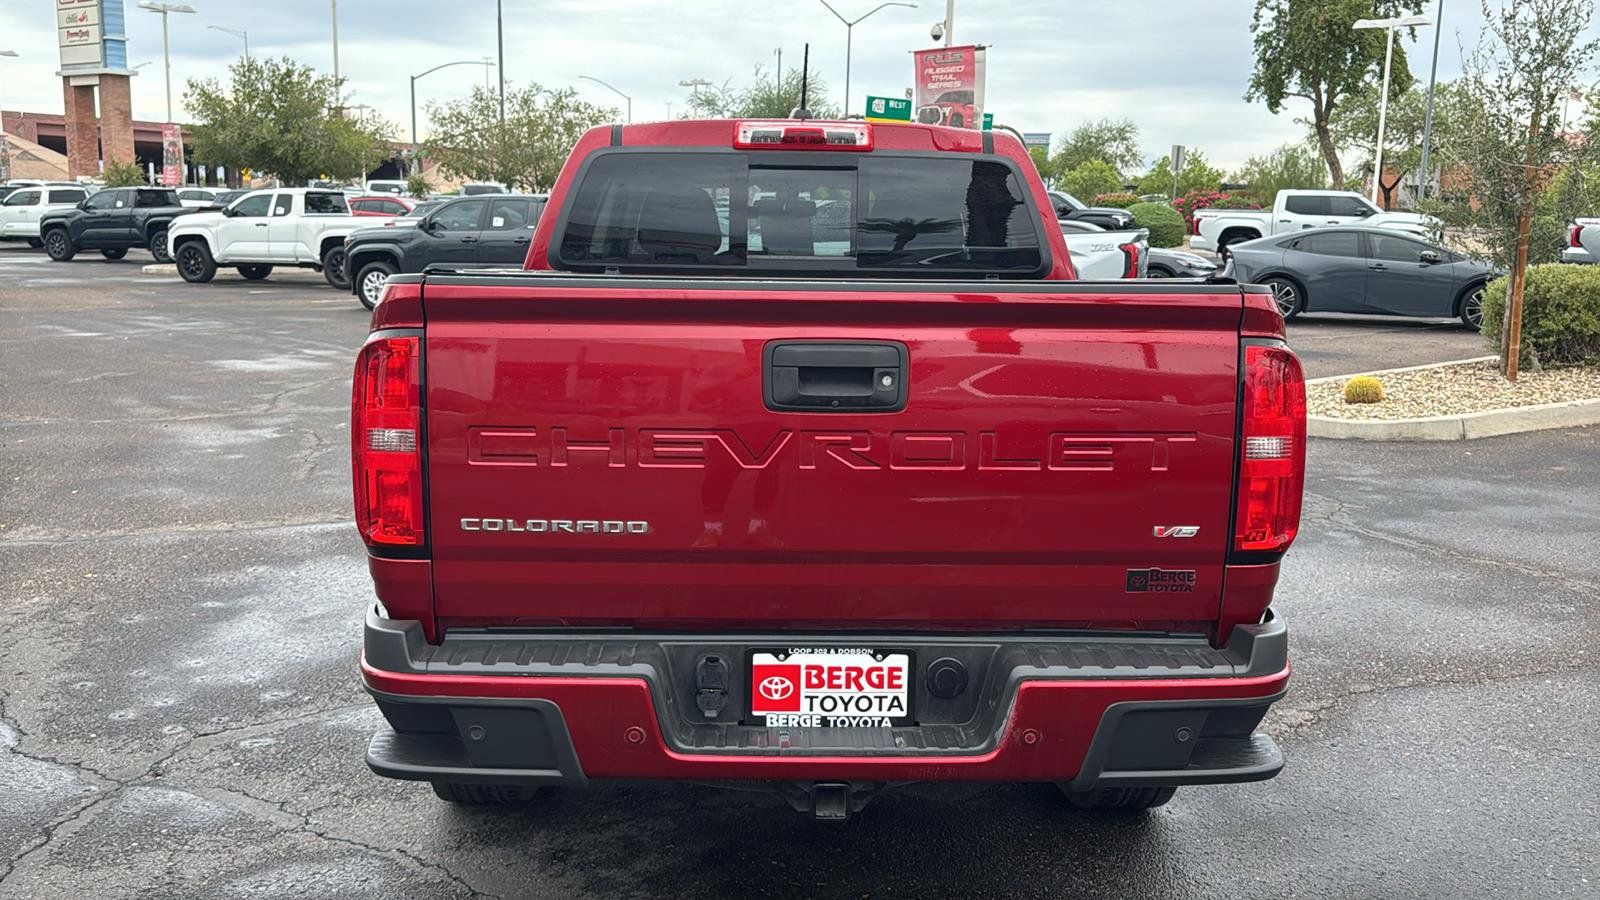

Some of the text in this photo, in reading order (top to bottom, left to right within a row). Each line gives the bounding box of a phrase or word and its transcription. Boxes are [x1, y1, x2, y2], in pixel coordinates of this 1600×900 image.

[924, 65, 965, 75] RUGGED
[927, 80, 962, 89] SERIES
[930, 74, 957, 82] TRAIL
[888, 100, 906, 109] WEST
[467, 425, 1198, 471] CHEVROLET
[460, 518, 648, 533] COLORADO
[1153, 526, 1201, 538] V6
[1149, 568, 1196, 582] BERGE
[1149, 583, 1193, 592] TOYOTA
[804, 665, 904, 692] BERGE
[804, 695, 905, 713] TOYOTA
[765, 713, 893, 728] BERGE TOYOTA
